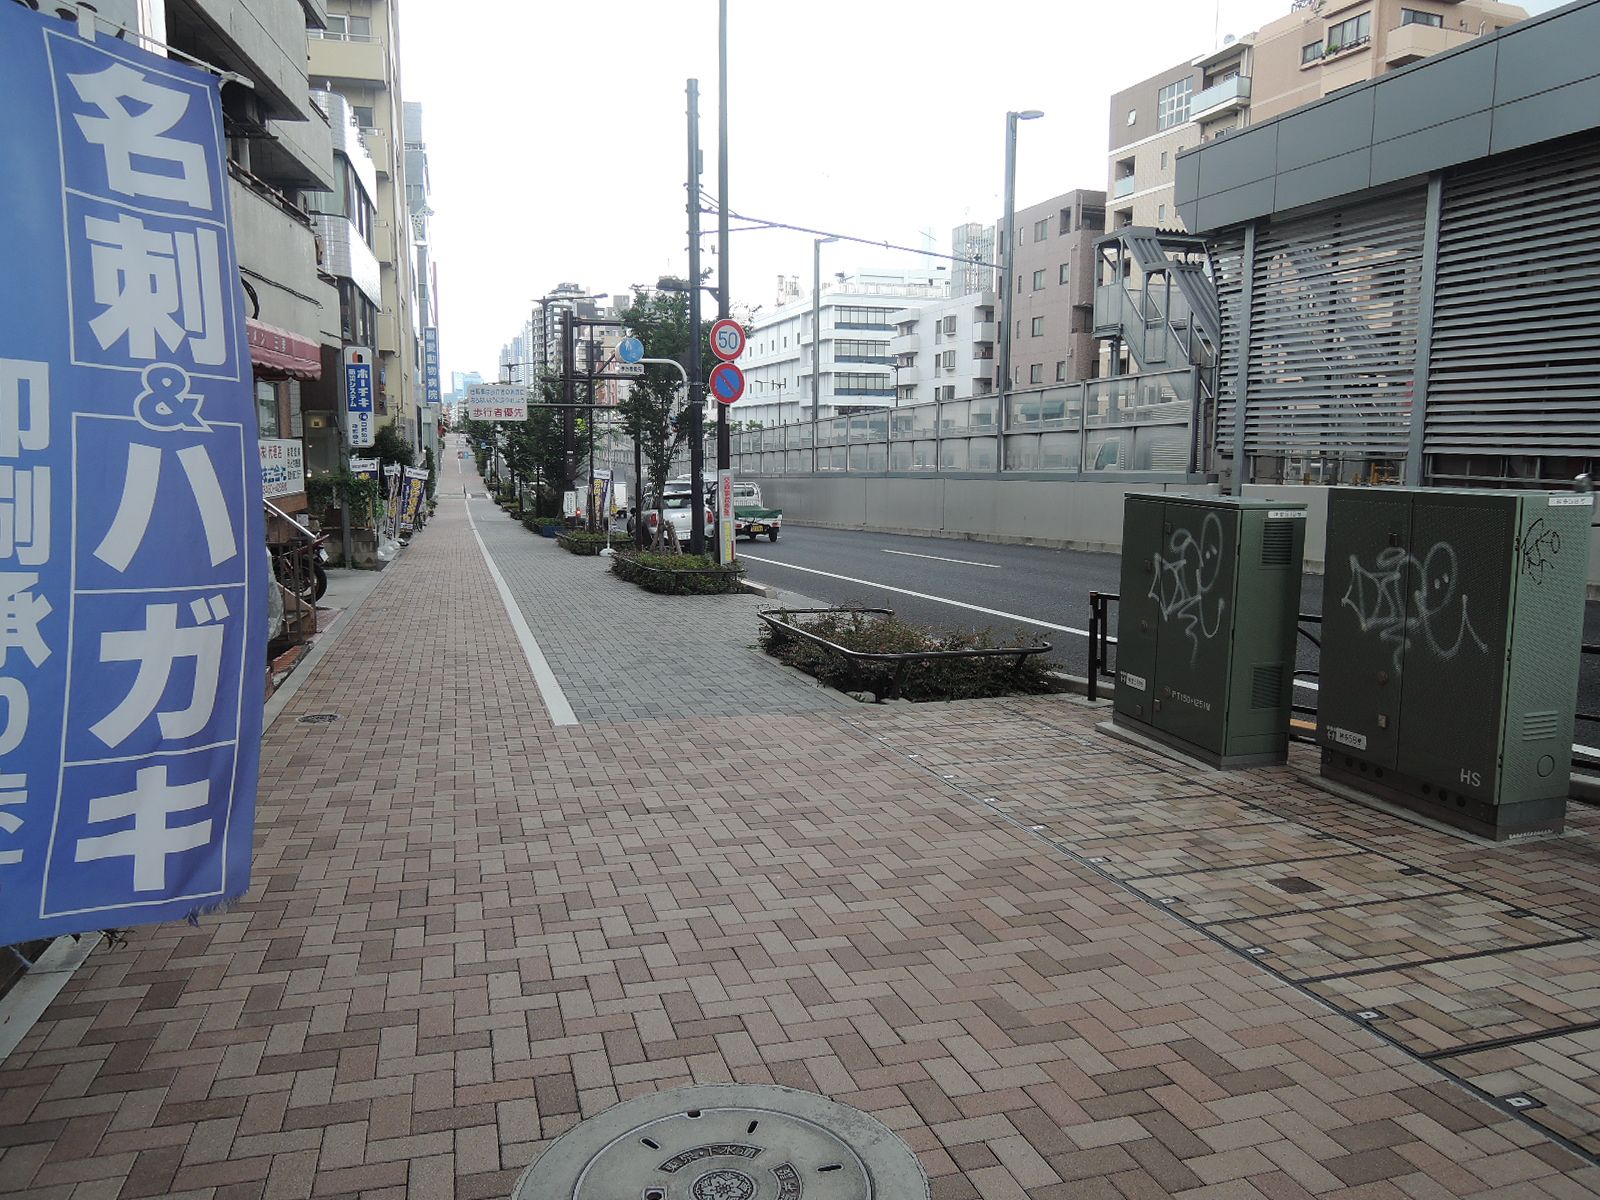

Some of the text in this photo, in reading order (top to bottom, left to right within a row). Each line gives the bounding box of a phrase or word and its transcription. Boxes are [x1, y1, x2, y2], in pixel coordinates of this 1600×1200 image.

[718, 331, 738, 350] 50
[357, 368, 370, 408] ホーチキ
[472, 407, 524, 418] 歩行者優先
[66, 62, 238, 892] 名刺&ハガキ
[1460, 767, 1482, 787] HS
